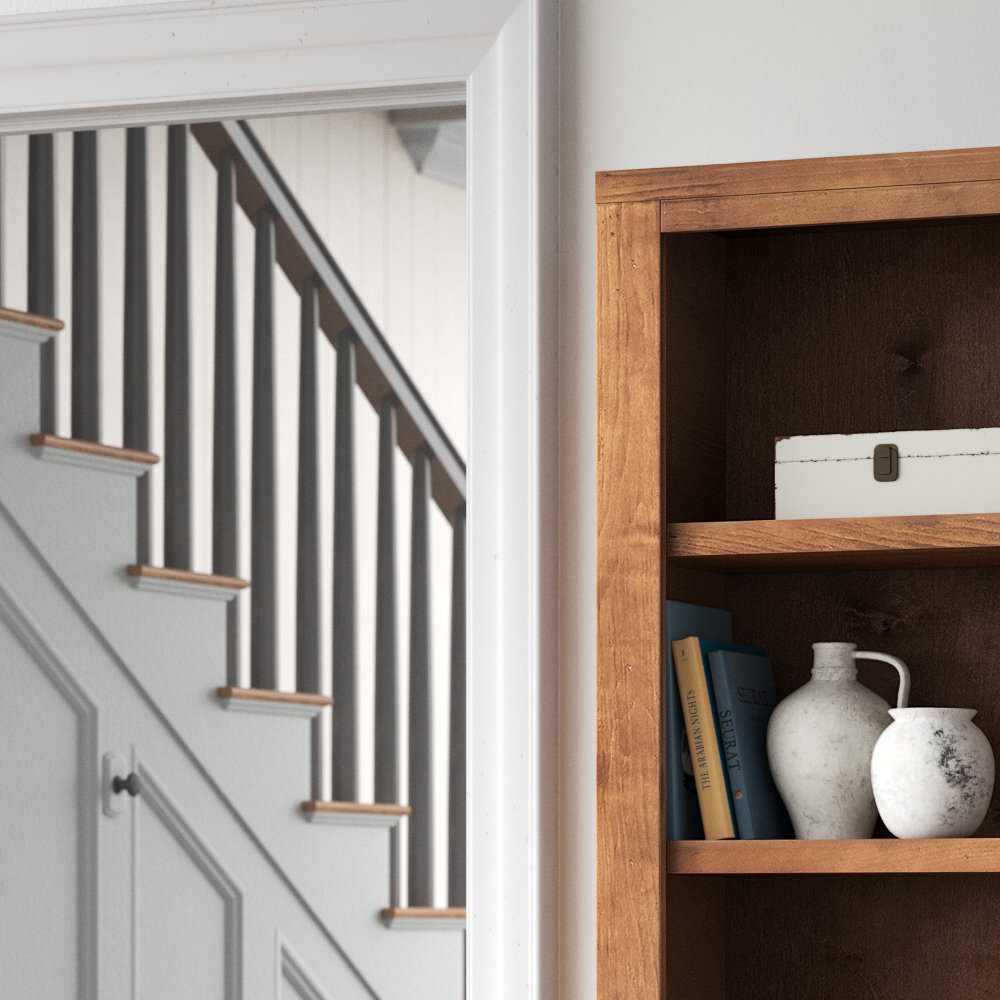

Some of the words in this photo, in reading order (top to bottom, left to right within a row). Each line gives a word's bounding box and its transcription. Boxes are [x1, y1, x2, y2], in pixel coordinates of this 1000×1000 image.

[686, 689, 700, 725] NIGHTS
[692, 727, 708, 768] ARABIAN
[719, 709, 741, 770] SEURAT
[701, 770, 711, 790] THE
